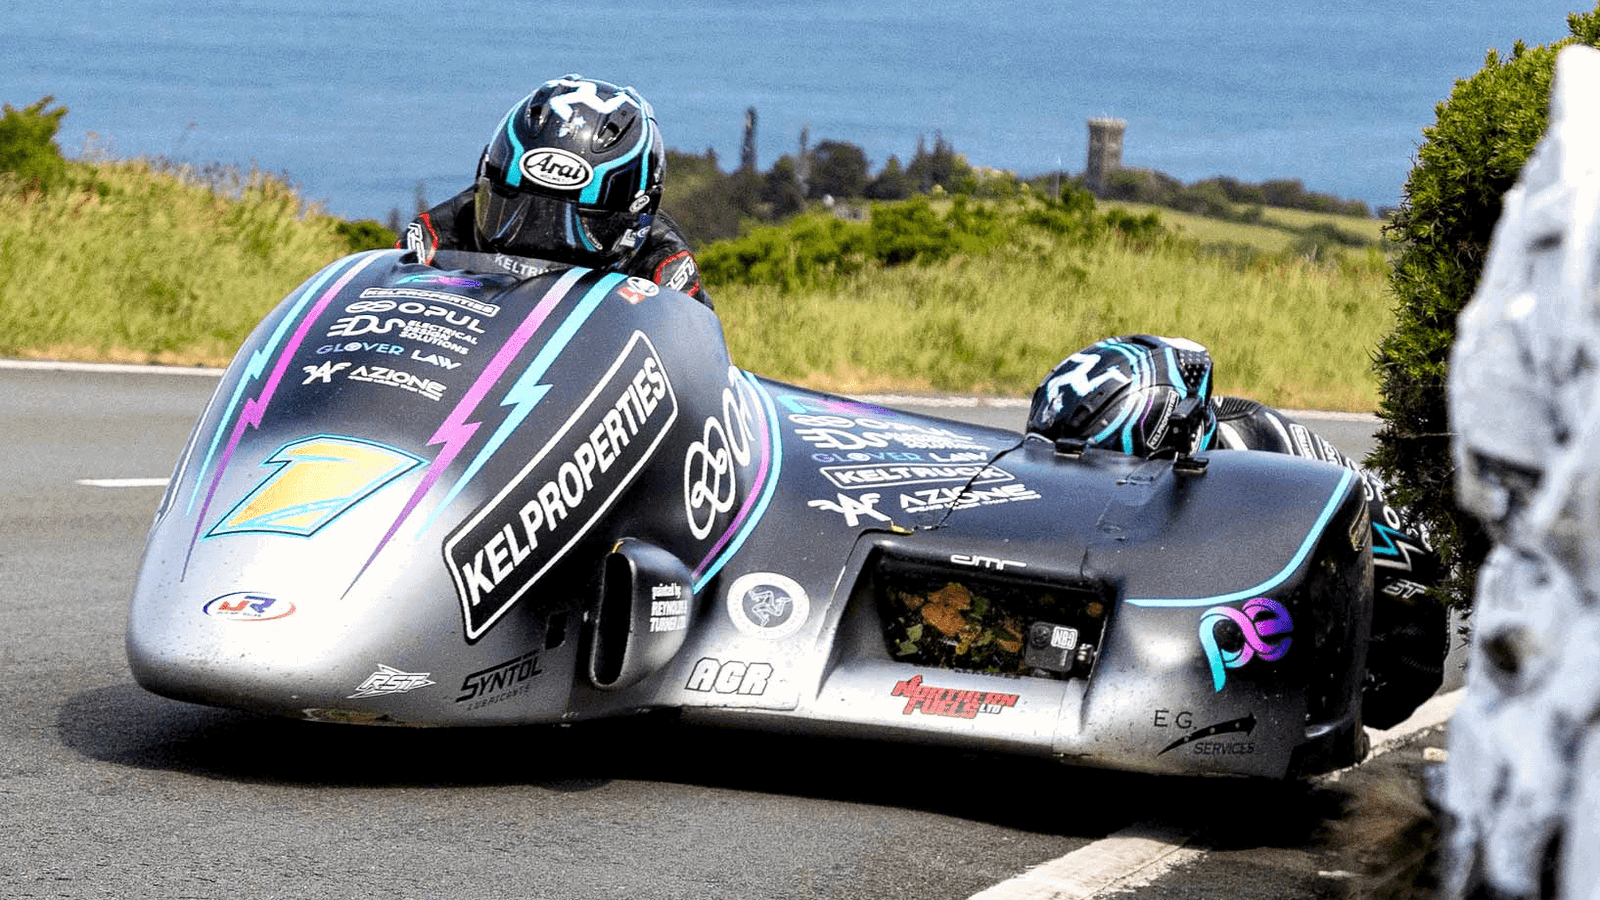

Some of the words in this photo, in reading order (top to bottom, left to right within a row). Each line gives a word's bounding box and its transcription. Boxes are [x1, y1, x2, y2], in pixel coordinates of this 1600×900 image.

[527, 154, 583, 179] Arai
[398, 302, 485, 334] OPUL
[399, 331, 469, 355] SOLUTIONS
[408, 320, 478, 345] ELECTRICAL
[316, 342, 404, 355] GLOVER
[411, 349, 462, 370] LAW
[349, 366, 447, 397] AZIONE
[811, 452, 921, 463] GLOVER
[462, 357, 667, 607] KELPROPERTIES
[834, 466, 1005, 484] KELTRUCK
[899, 484, 1033, 509] AZIONE
[455, 651, 542, 703] SYNTOL
[1194, 742, 1256, 755] SERVICES
